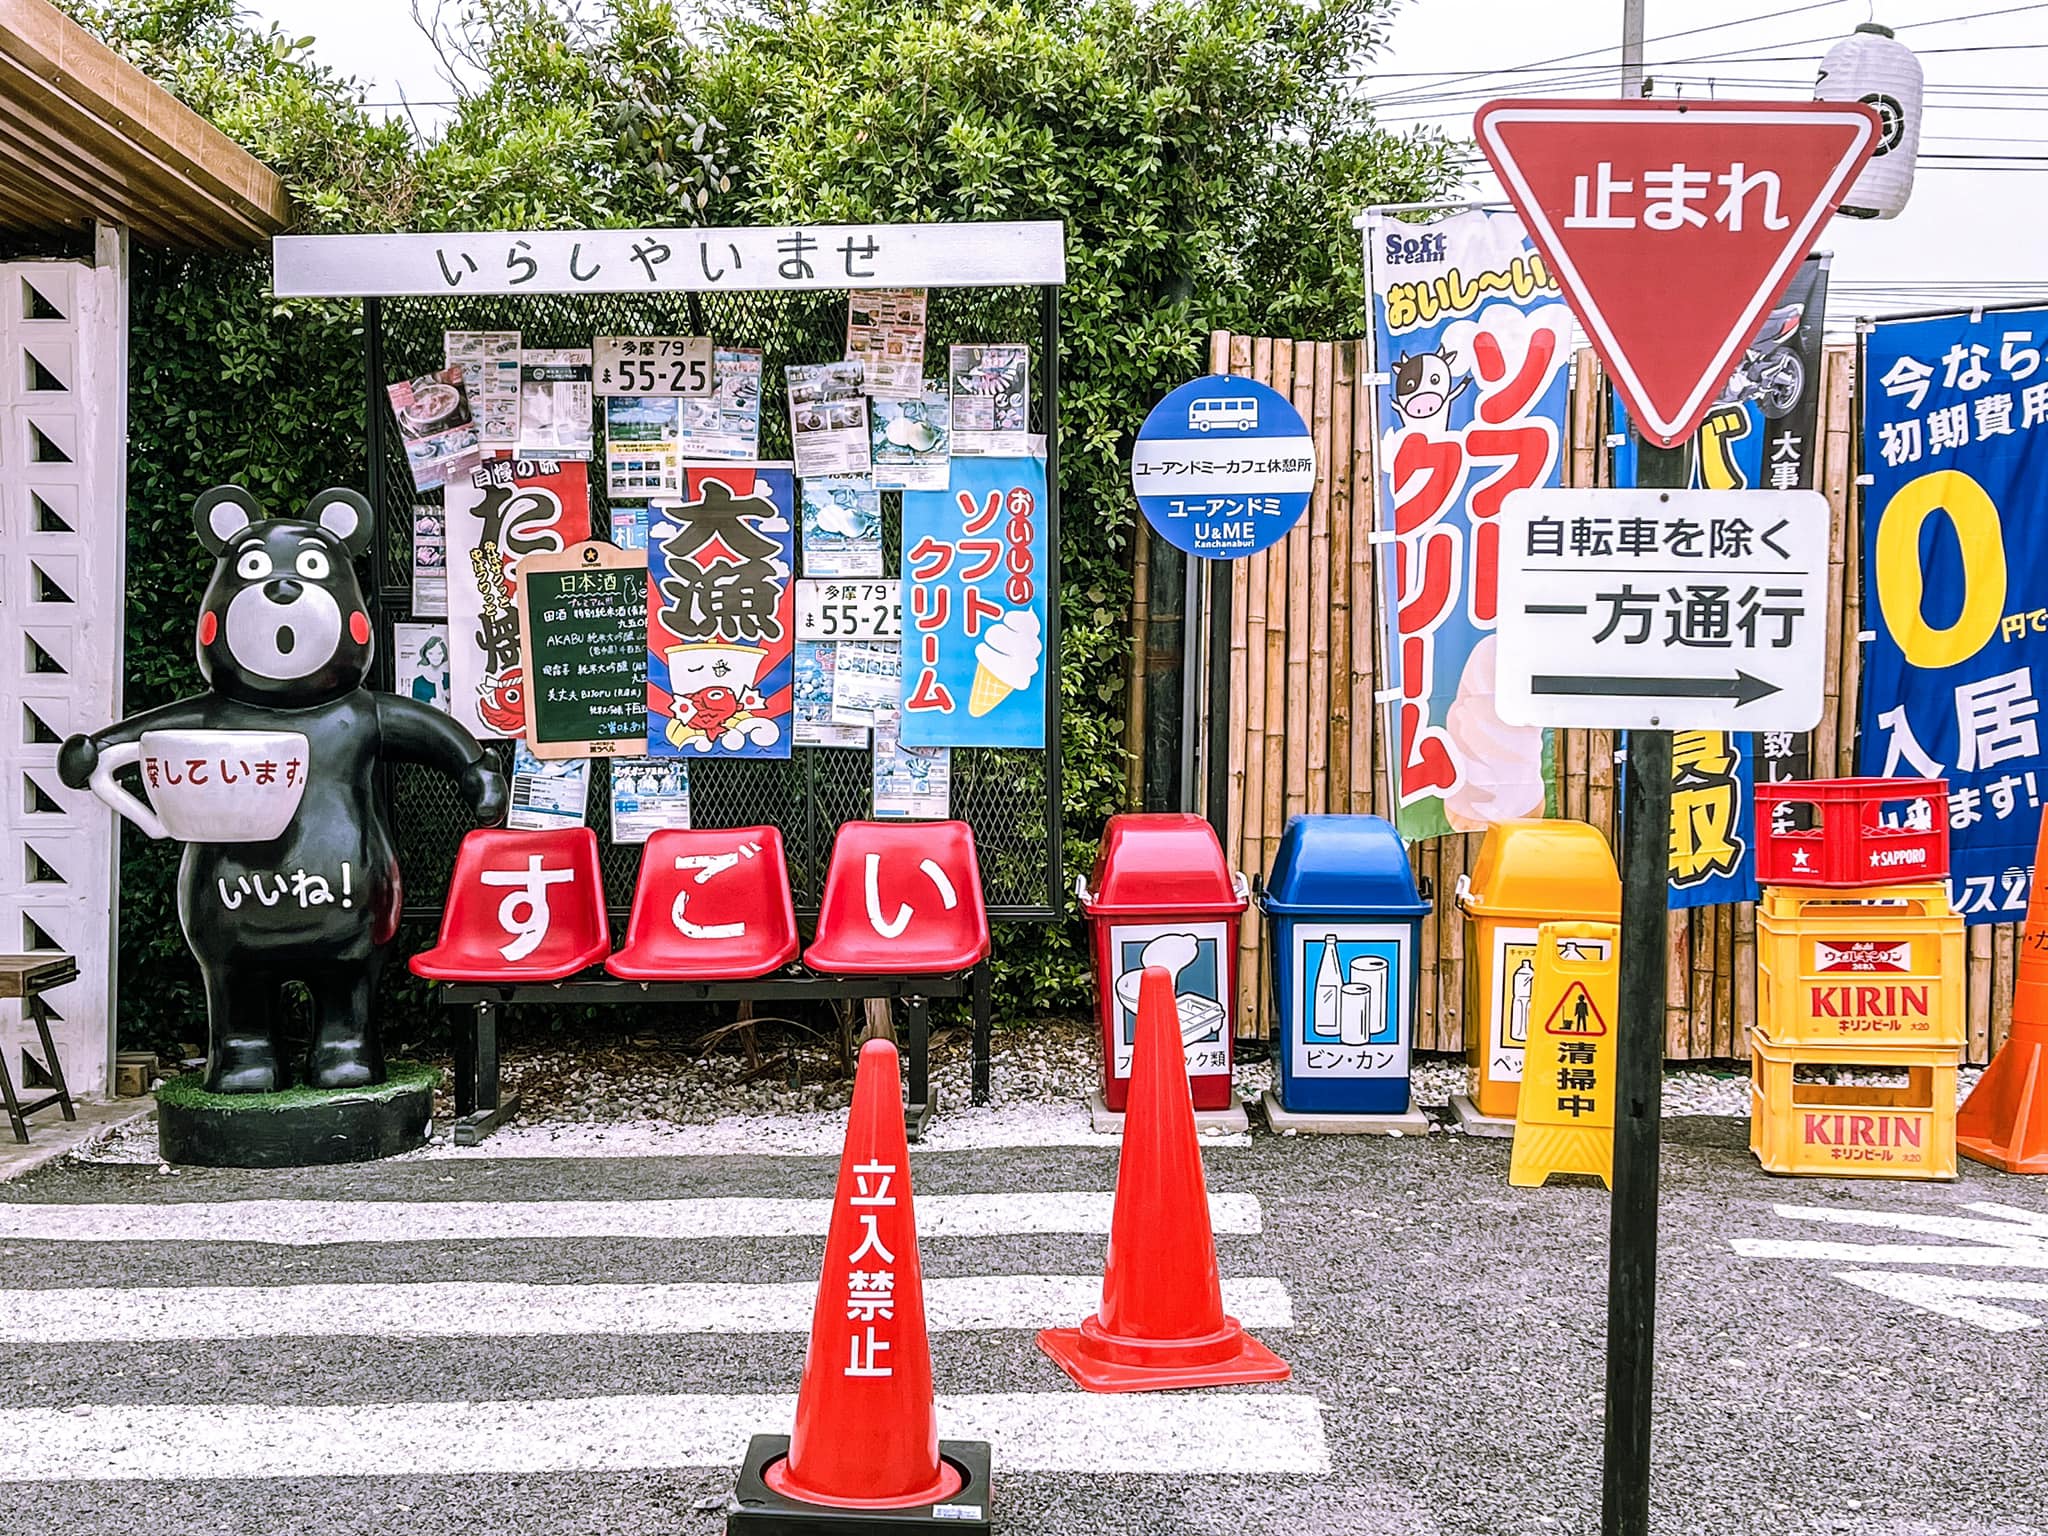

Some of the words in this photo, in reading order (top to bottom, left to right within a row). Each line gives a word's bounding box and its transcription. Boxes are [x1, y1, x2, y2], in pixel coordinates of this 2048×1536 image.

[1563, 162, 1790, 232] 止まれ
[436, 231, 880, 287] いらしやいませ
[1386, 232, 1447, 254] Soft
[1386, 250, 1446, 264] cream
[619, 360, 706, 392] 55-25
[1878, 381, 2048, 467] 初期費用
[474, 460, 560, 488] 自慢の味
[1136, 458, 1312, 476] ユーアンドミーカフェ休憩所
[1167, 497, 1281, 518] ユーアンドミ
[1008, 488, 1032, 602] おいしい
[1194, 521, 1256, 540] U&ME
[1194, 539, 1255, 549] Kanchanaburi
[1527, 515, 1791, 560] 自転車を除く
[660, 480, 784, 640] 大漁
[958, 492, 1002, 635] ソフト
[560, 573, 617, 593] 日本酒
[908, 538, 953, 711] クリーム
[1524, 584, 1805, 648] 一方通行
[546, 633, 584, 647] AKABU
[1878, 667, 2040, 780] 入居
[1880, 848, 1926, 867] SAPPORO
[218, 861, 352, 910] いいね!
[1811, 986, 1928, 1017] KIRIN
[1838, 1019, 1901, 1032] キリンビール
[1307, 1049, 1394, 1070] ビン・カン
[1557, 1041, 1598, 1118] 清掃中
[1804, 1114, 1921, 1148] KIRIN
[1831, 1148, 1894, 1162] キリンビール
[843, 1158, 897, 1378] 立入禁止
